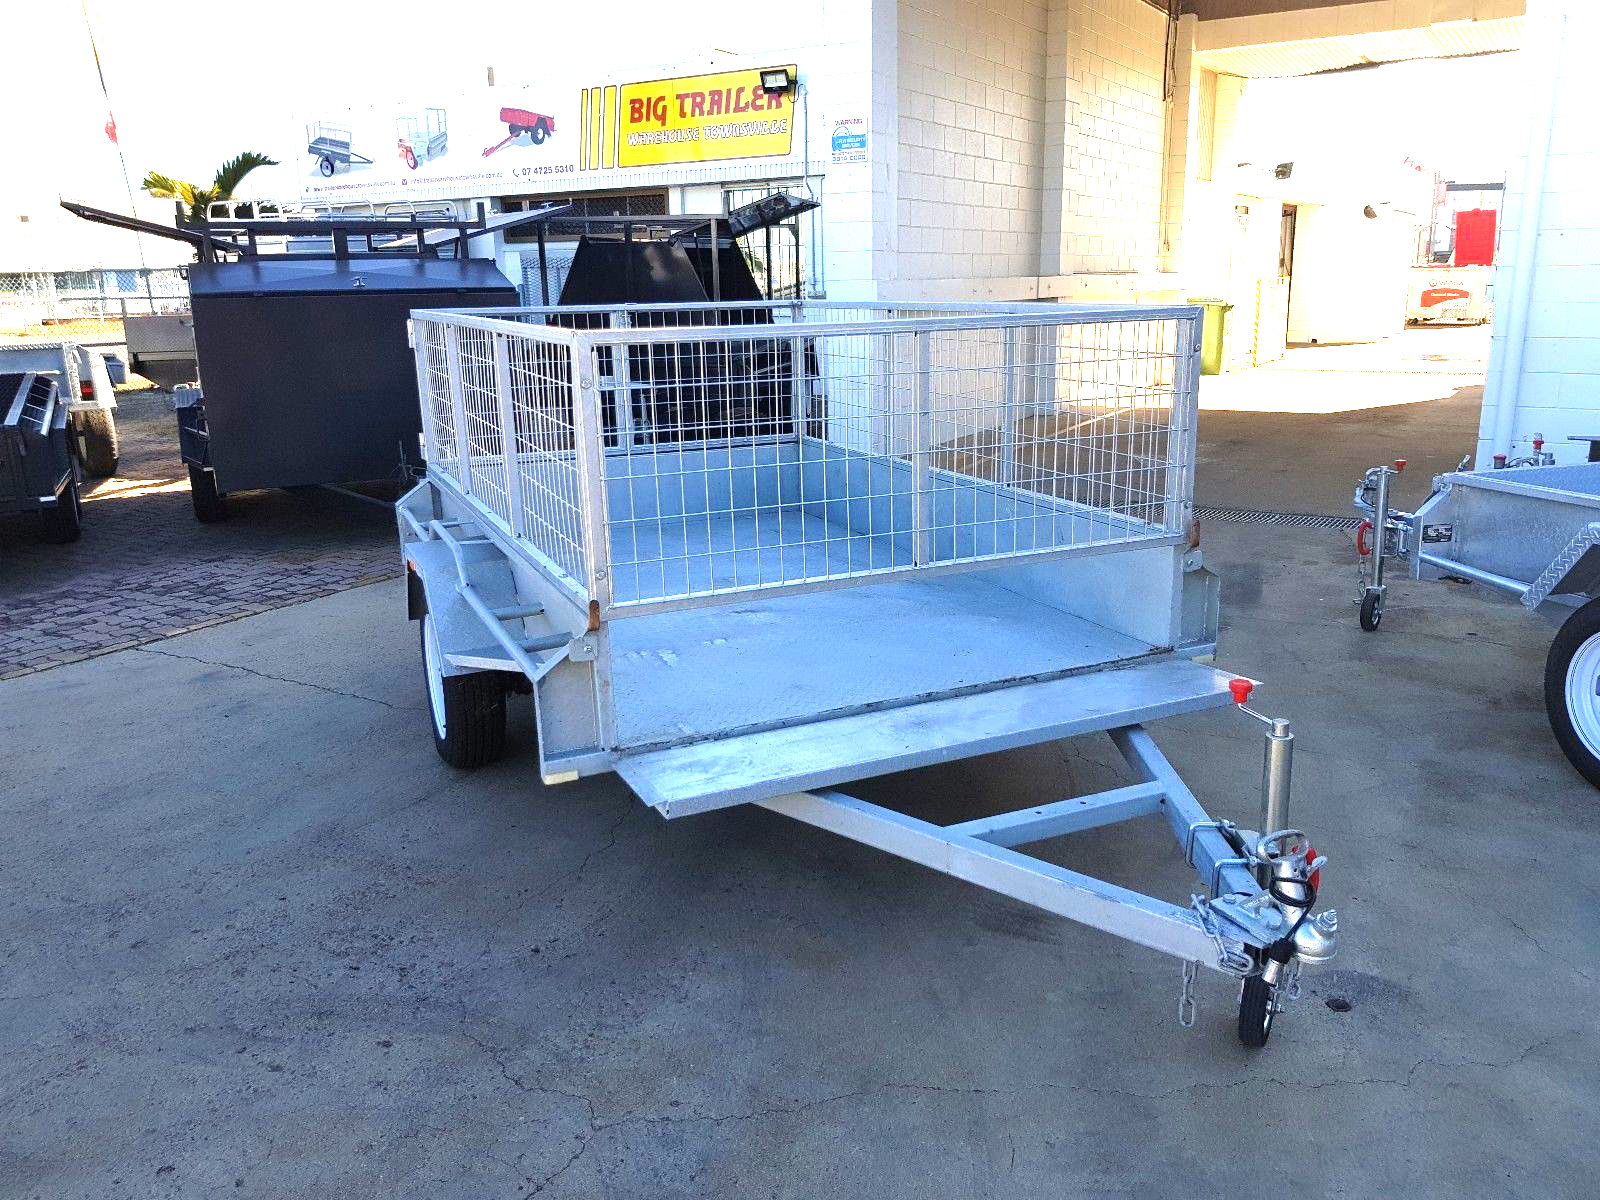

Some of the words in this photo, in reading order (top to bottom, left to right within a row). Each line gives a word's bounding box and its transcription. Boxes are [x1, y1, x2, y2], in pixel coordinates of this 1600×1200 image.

[629, 95, 668, 127] BIG
[627, 127, 700, 146] WAREHOUSE
[704, 119, 788, 139] TOWNSVILLE
[522, 167, 531, 176] 07
[533, 166, 553, 175] 4725
[554, 164, 574, 174] 5310
